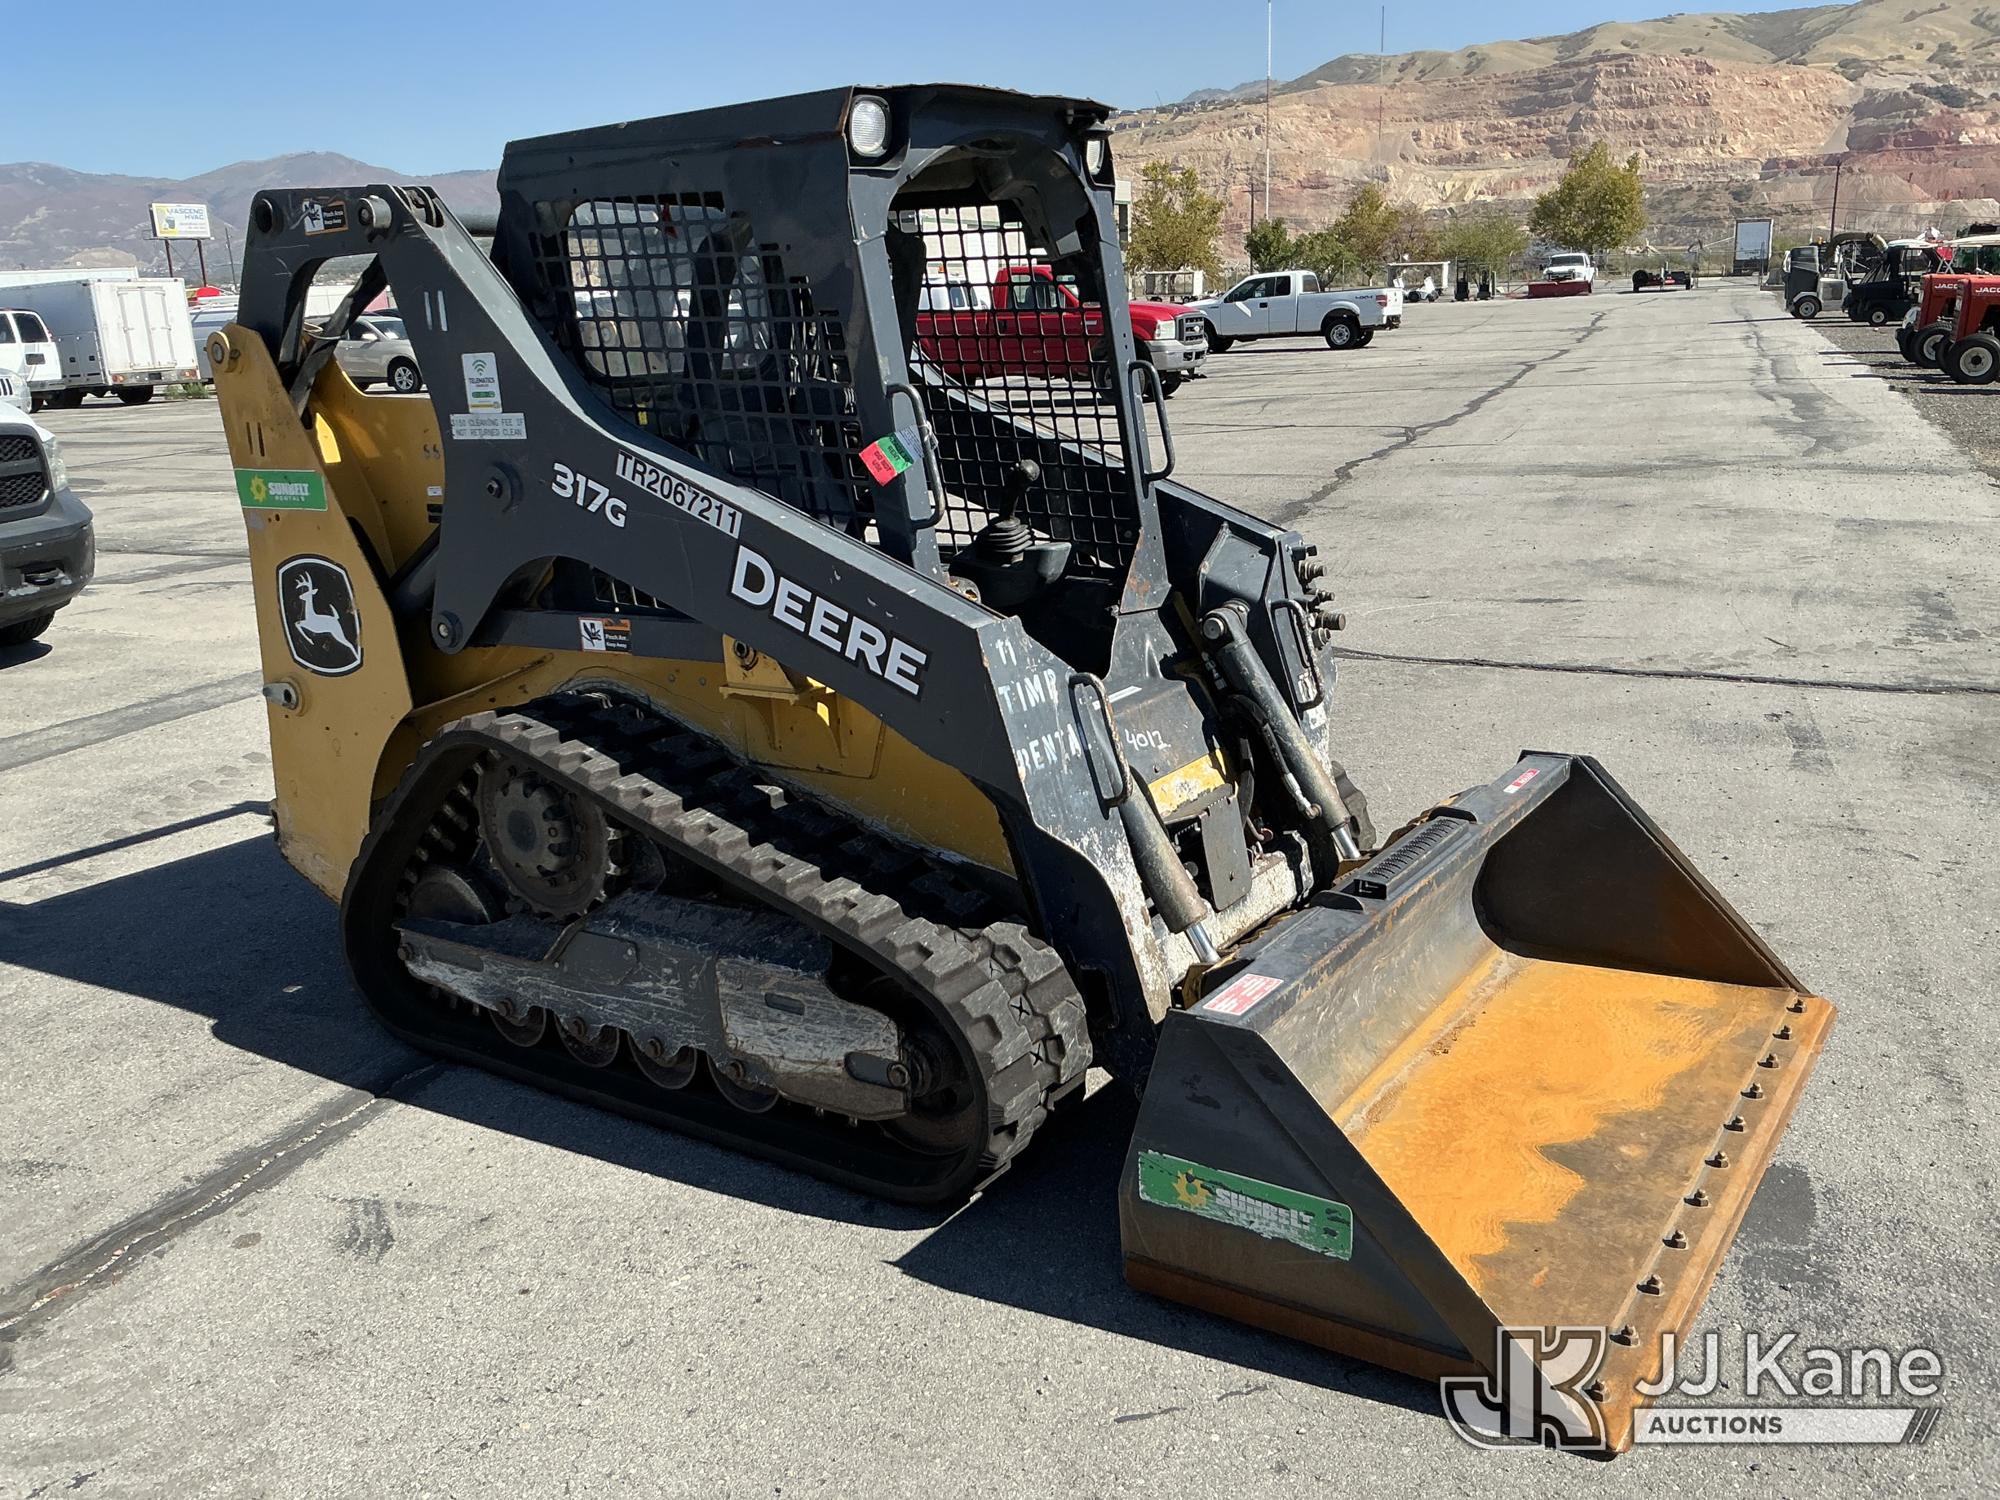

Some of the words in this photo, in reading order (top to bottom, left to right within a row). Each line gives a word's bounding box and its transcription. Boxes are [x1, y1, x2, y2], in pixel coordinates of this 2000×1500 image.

[268, 482, 309, 496] SUNBELT
[551, 462, 628, 528] 317G
[618, 450, 738, 535] TR2067211
[731, 544, 927, 696] DEERE
[1215, 1188, 1314, 1232] SUNBELT
